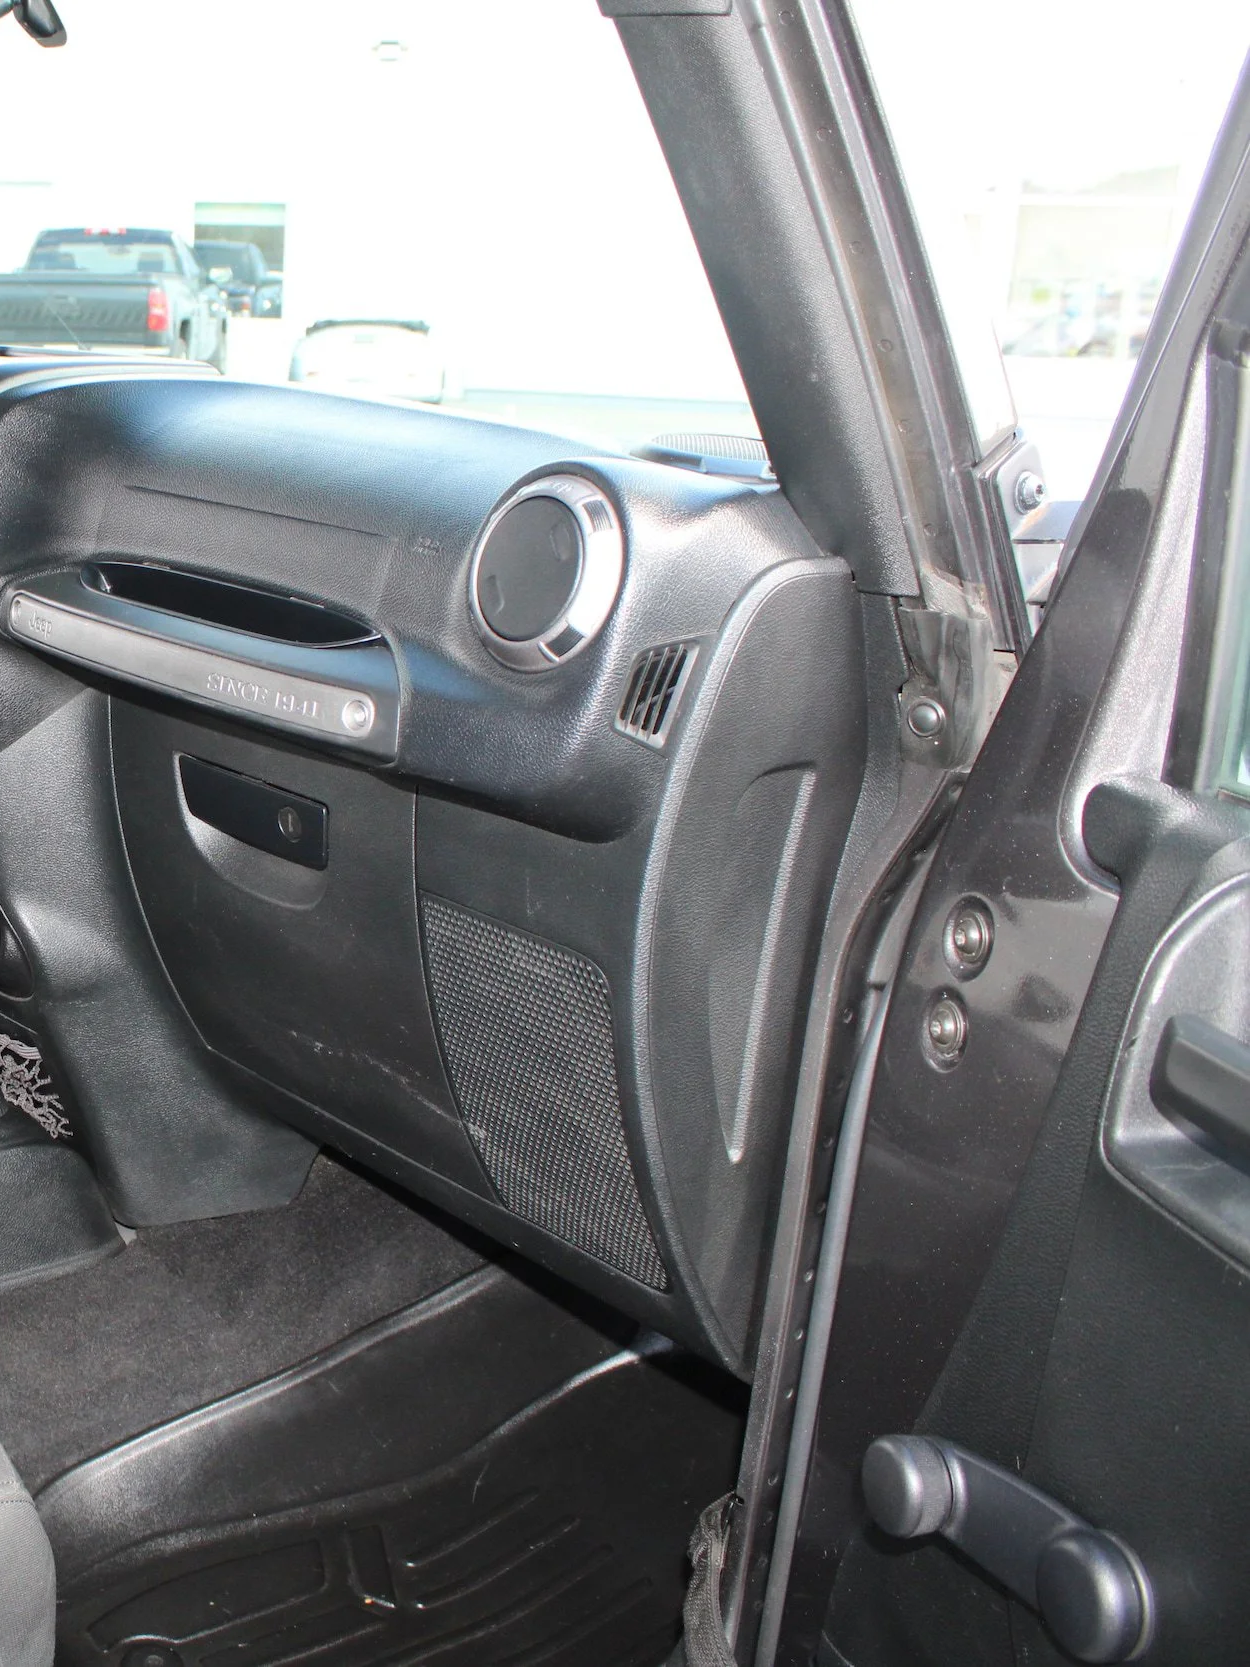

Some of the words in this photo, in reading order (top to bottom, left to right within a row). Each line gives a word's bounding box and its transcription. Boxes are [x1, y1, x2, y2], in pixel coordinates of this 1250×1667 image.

[29, 609, 53, 640] Jeep
[207, 673, 269, 705] SINCE
[275, 691, 320, 719] 1941
